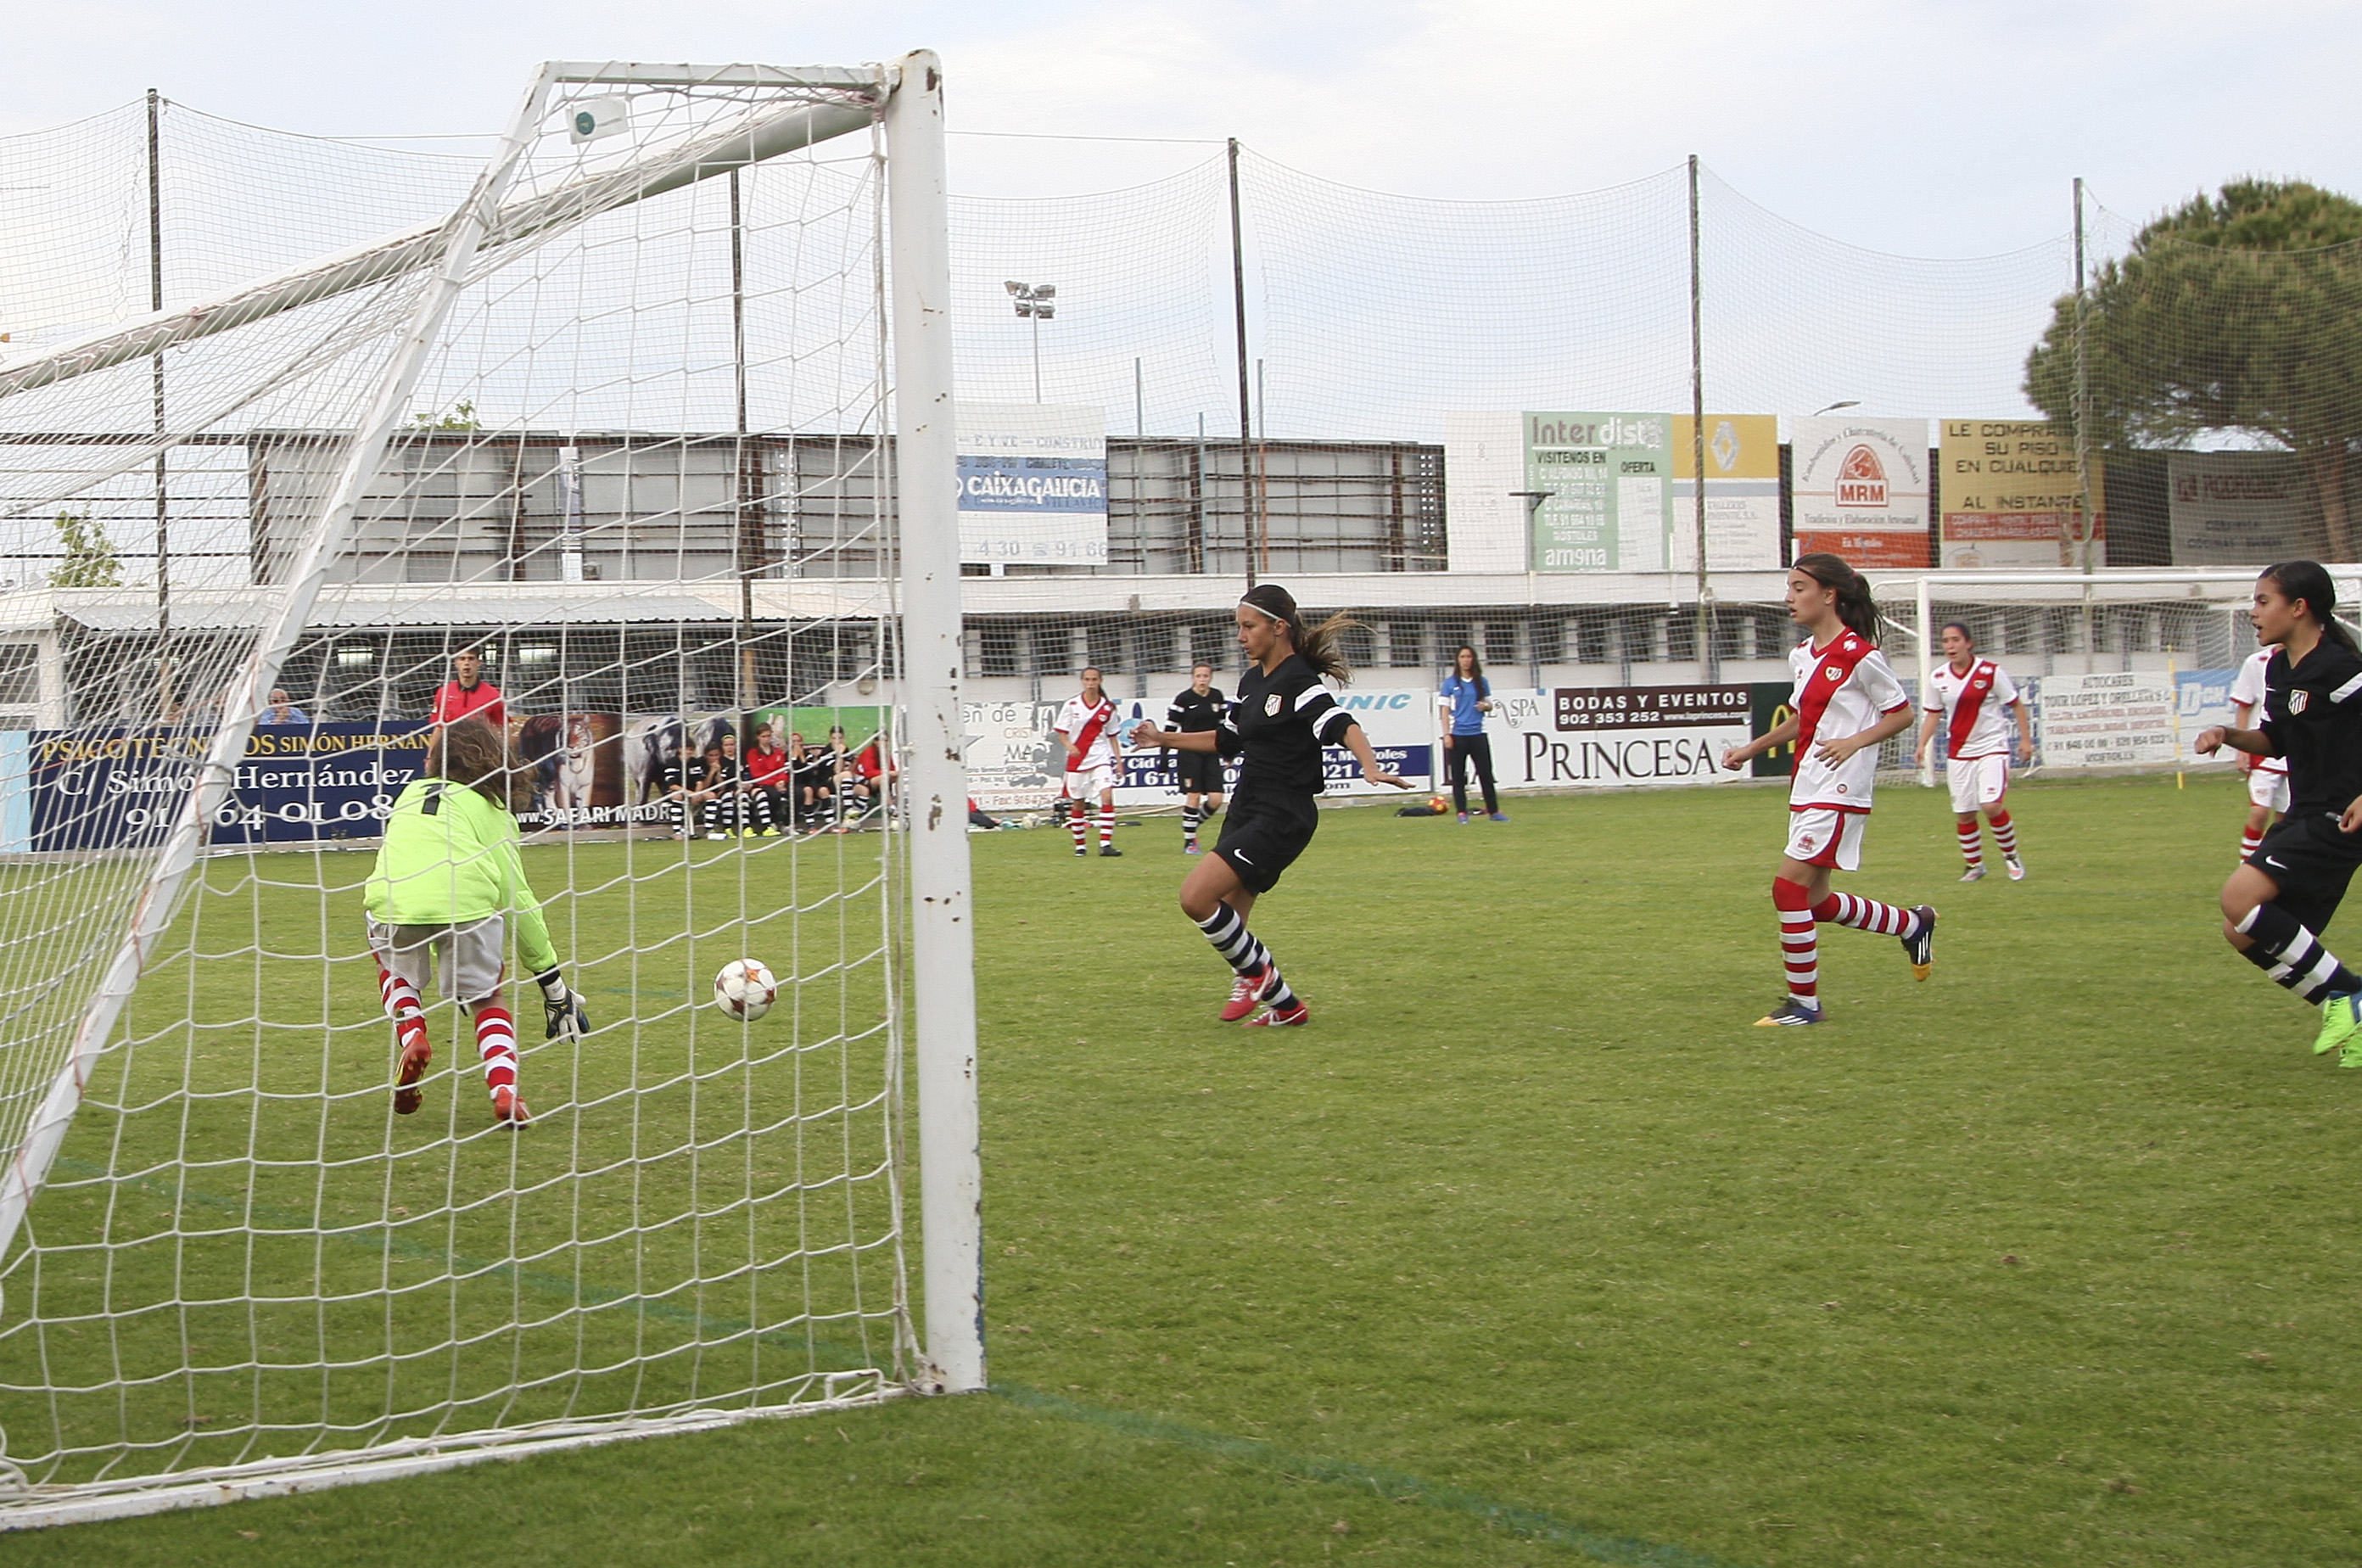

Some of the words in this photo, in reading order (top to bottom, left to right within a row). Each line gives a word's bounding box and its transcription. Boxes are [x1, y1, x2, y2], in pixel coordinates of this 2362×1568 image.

[1949, 423, 1972, 437] LE
[1985, 442, 2008, 455] SU
[2018, 442, 2058, 455] PISO
[1620, 462, 1656, 473] OFERTA
[1956, 460, 1980, 473] EN
[1990, 459, 2081, 475] CUALQUIE
[1840, 485, 1884, 501] MRM
[1962, 496, 1986, 509] AL
[1510, 698, 1540, 717] SPA
[1559, 696, 1627, 711] BODAS
[1637, 695, 1649, 708] Y
[1658, 692, 1748, 708] EVENTOS
[1559, 713, 1590, 725] 902
[1595, 712, 1626, 725] 353
[1630, 711, 1660, 723] 252
[42, 732, 277, 762] PSICOTÉCNOS
[280, 731, 346, 753] SIMÓN
[350, 731, 433, 751] HERNÁN
[1128, 756, 1156, 769] Cid
[1522, 731, 1718, 782] PRINCESA
[108, 766, 197, 793] Simó
[232, 762, 416, 790] Hernández
[125, 807, 171, 835] 91
[214, 798, 266, 831] 64
[339, 793, 395, 821] 08
